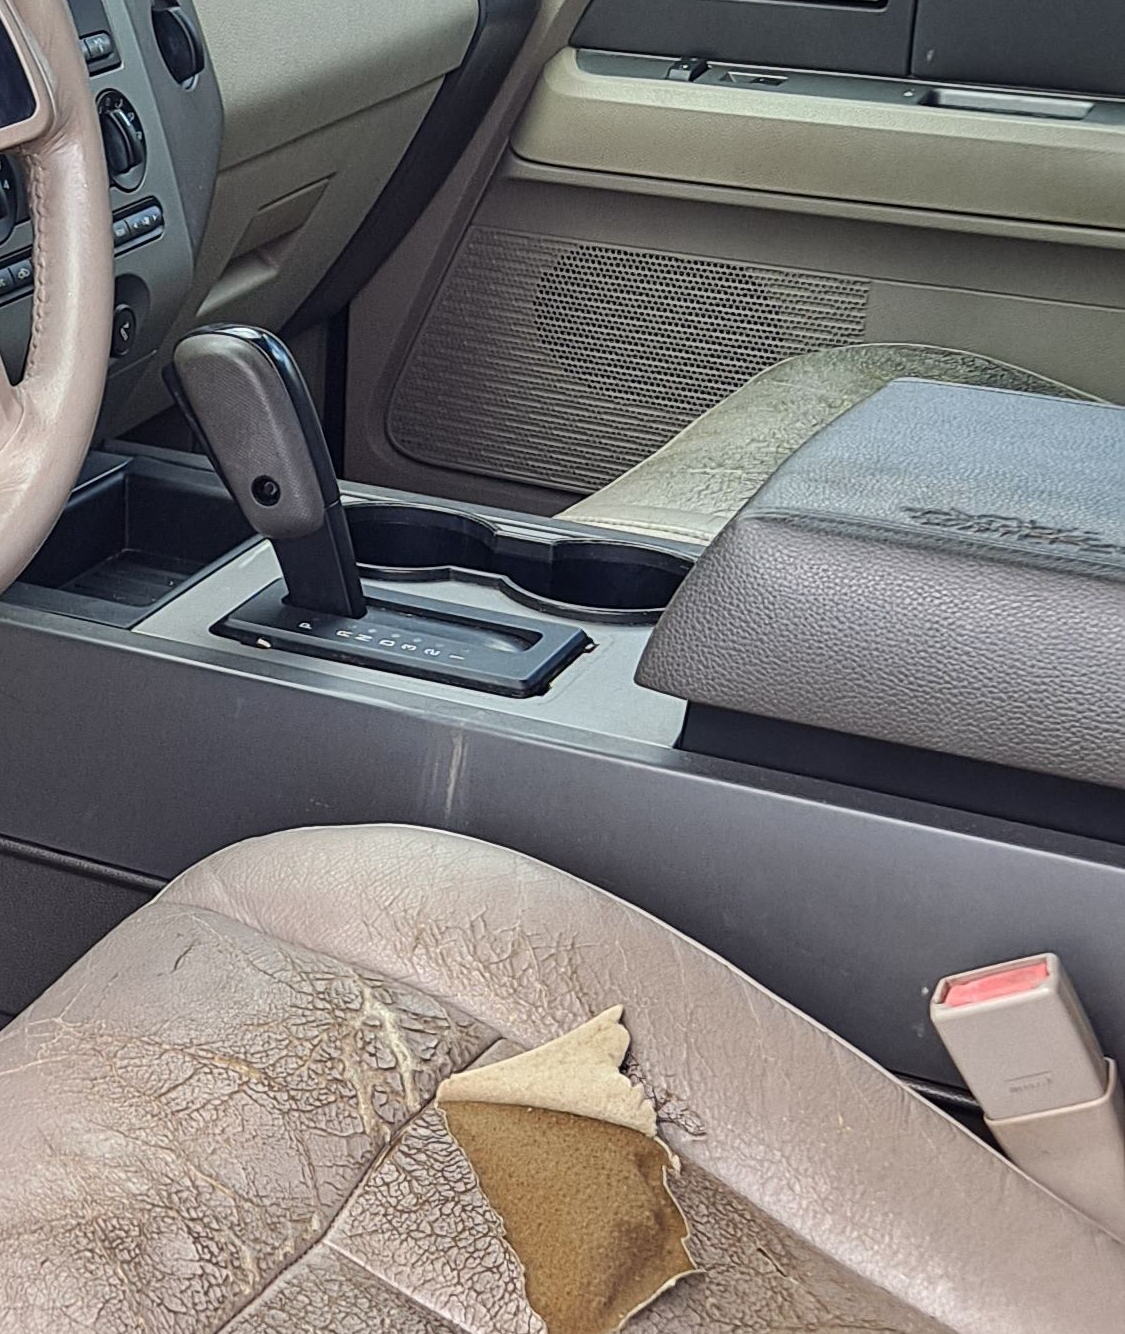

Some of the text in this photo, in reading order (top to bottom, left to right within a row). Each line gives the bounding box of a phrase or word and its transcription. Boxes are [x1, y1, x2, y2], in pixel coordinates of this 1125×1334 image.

[2, 179, 11, 190] 4
[298, 622, 313, 630] P
[336, 630, 353, 638] R
[354, 633, 373, 642] N
[378, 639, 395, 647] D
[401, 643, 417, 651] 3
[423, 648, 441, 656] 2
